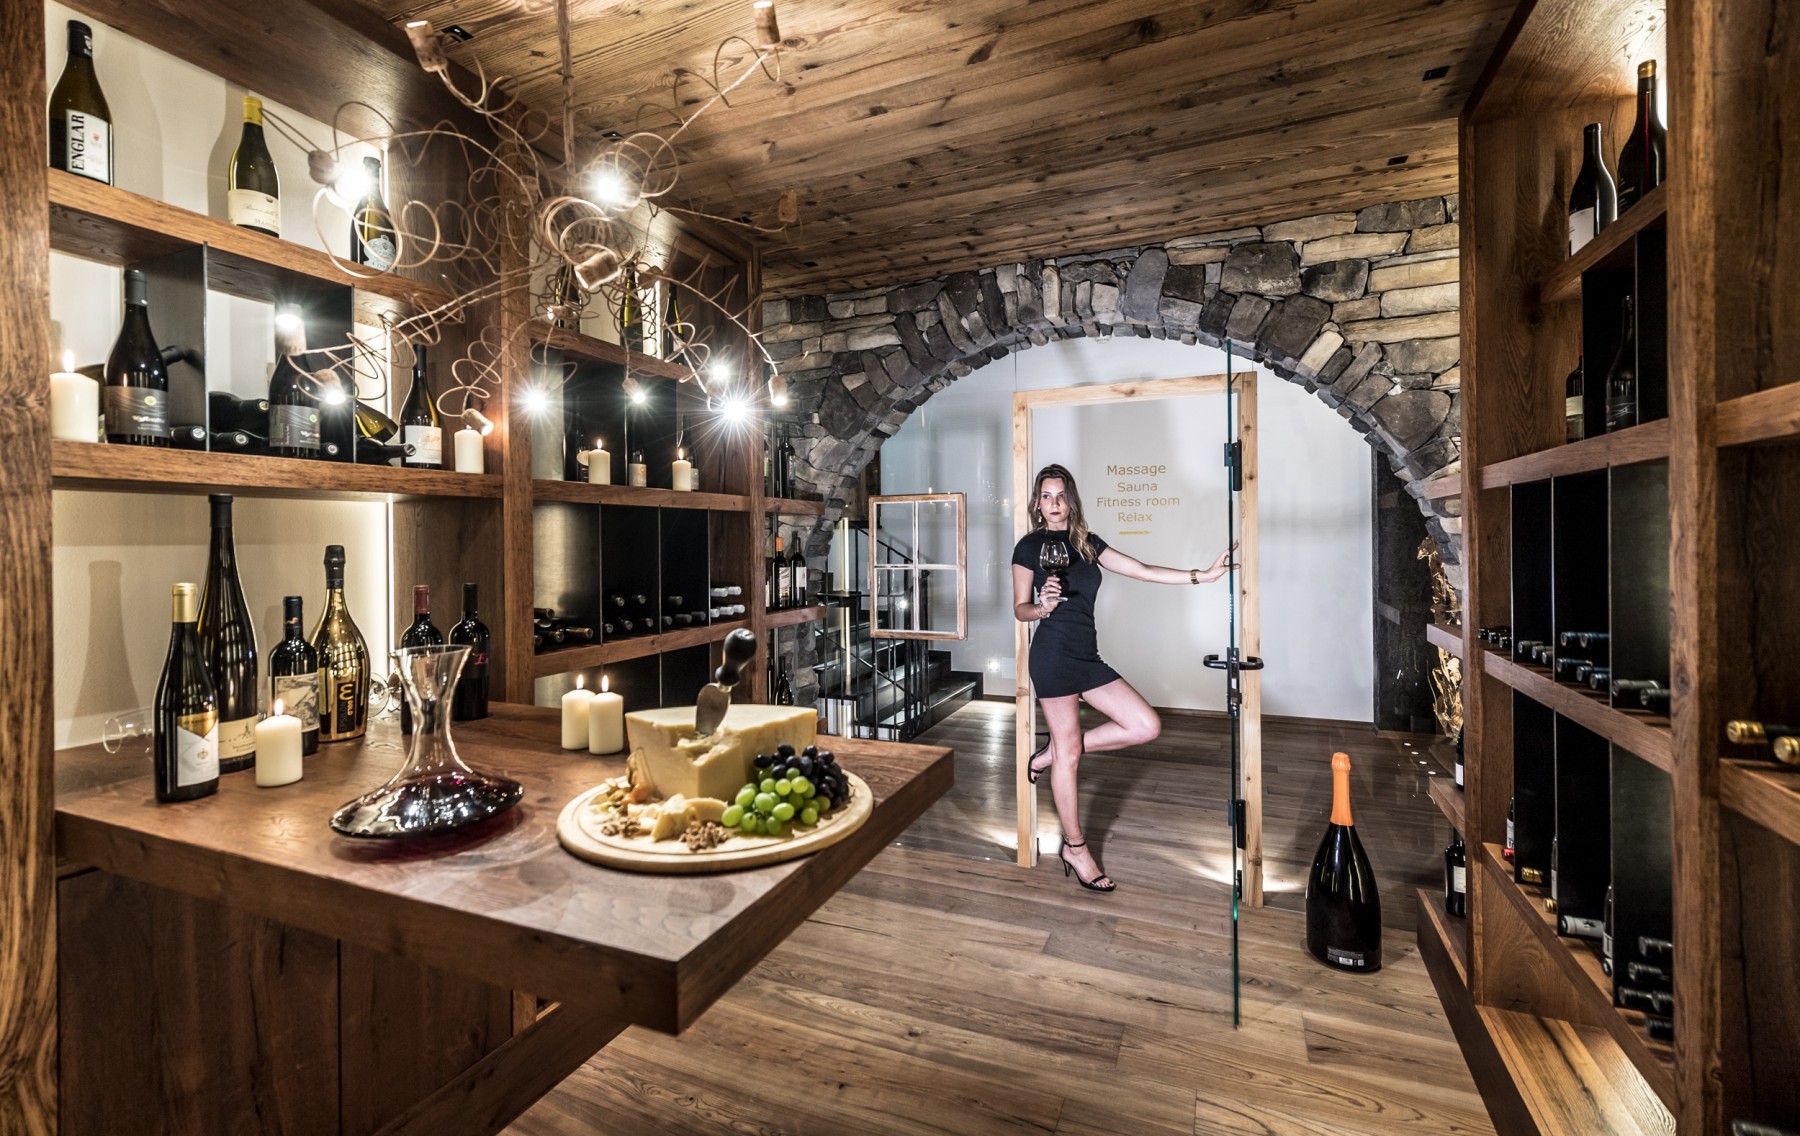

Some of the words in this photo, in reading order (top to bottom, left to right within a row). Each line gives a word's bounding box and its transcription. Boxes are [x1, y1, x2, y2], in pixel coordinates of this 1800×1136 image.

[71, 114, 85, 171] ENGLAR
[1106, 464, 1167, 477] Massage
[1117, 481, 1158, 493] Sauna
[1096, 496, 1141, 508] Fitness
[1146, 496, 1180, 507] room
[1117, 512, 1153, 523] Relax
